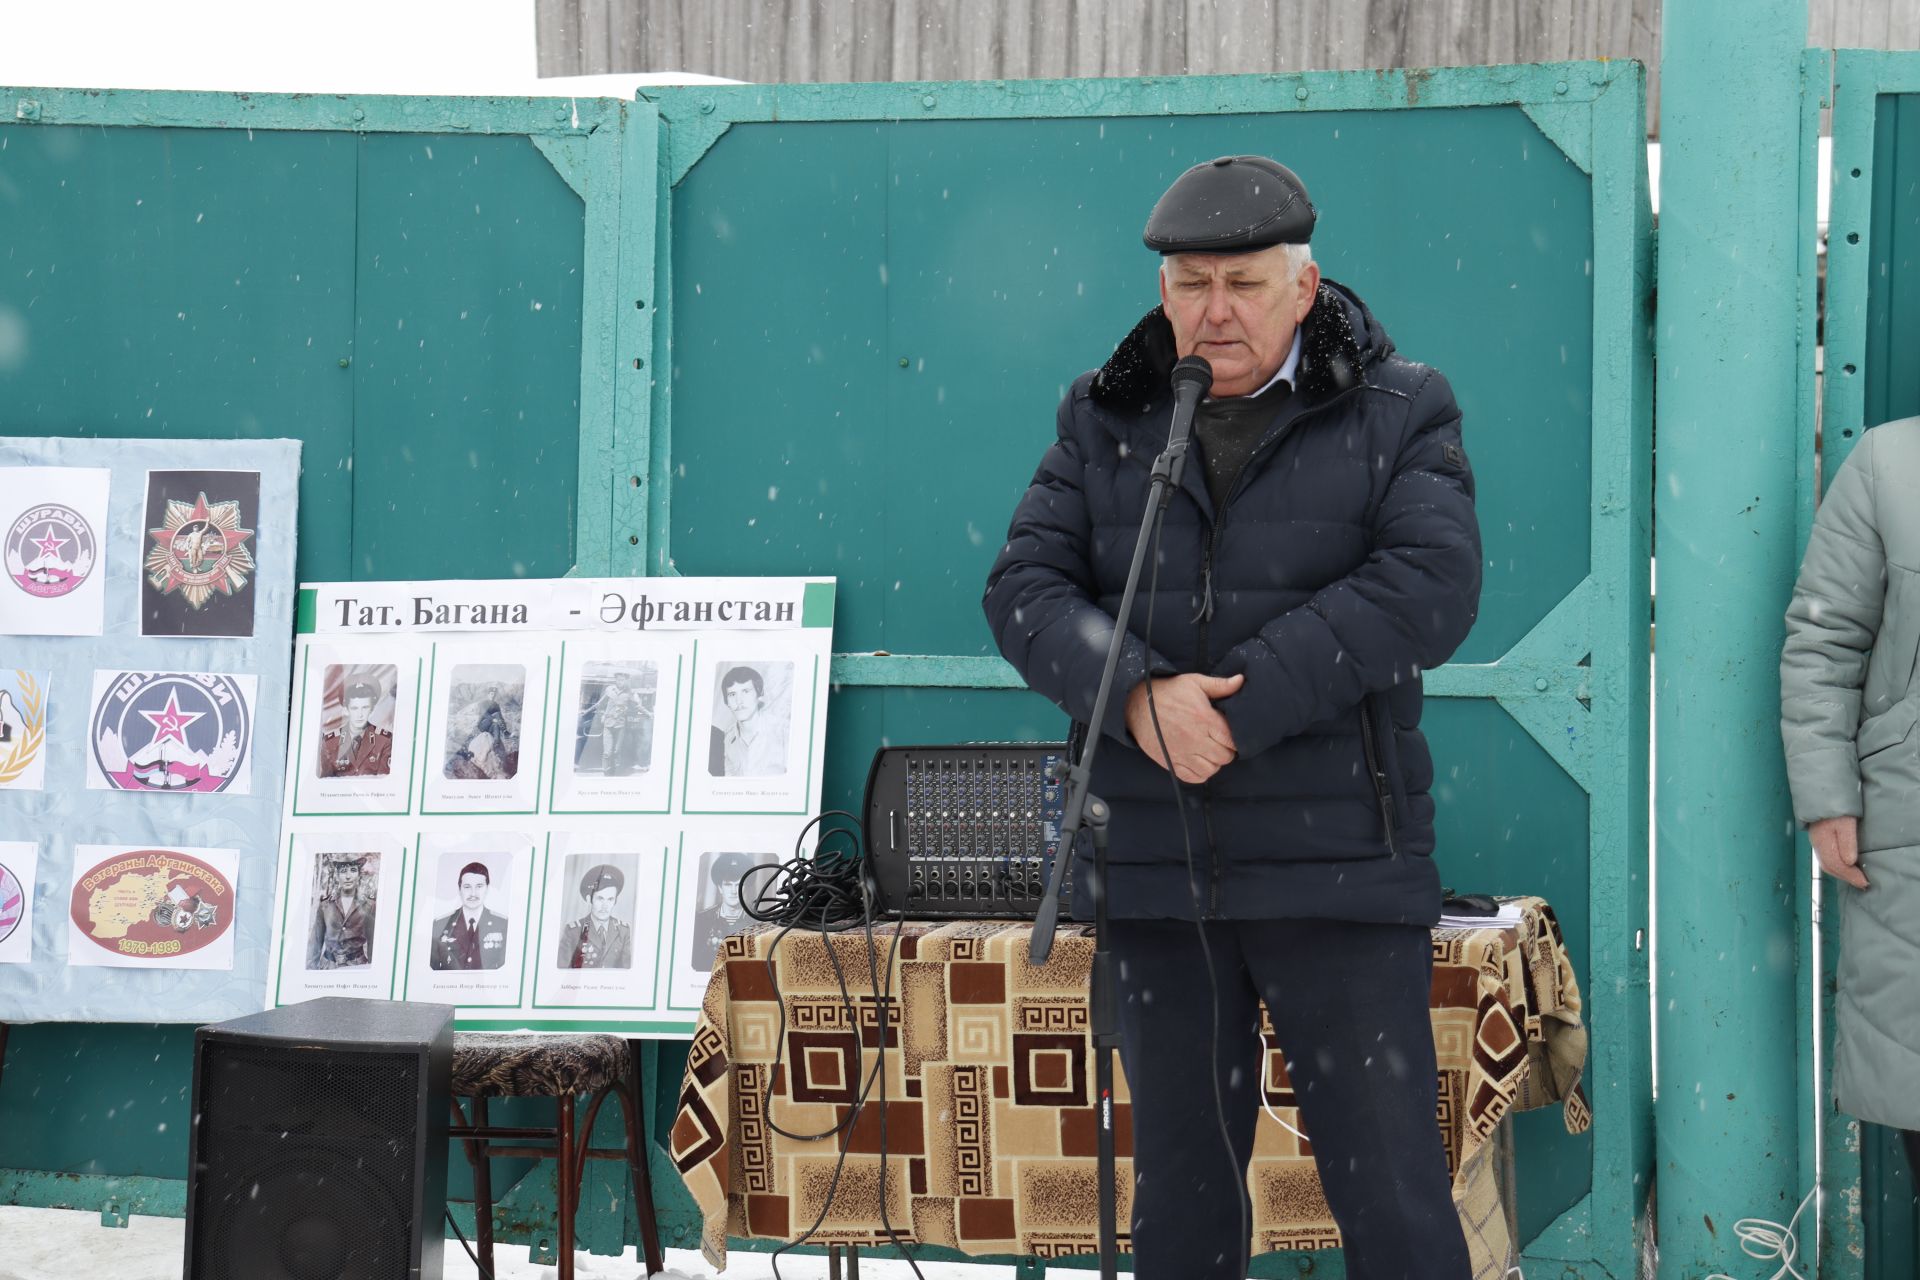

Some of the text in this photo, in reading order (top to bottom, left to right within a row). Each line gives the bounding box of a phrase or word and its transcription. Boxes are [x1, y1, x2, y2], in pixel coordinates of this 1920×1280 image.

[15, 509, 86, 535] ШУРАВИ
[335, 599, 402, 627] Тат.
[411, 597, 529, 625] Багана
[599, 593, 795, 630] Әфганстан
[82, 855, 226, 896] Ветераны Афганистана
[118, 938, 182, 955] 1979-1989
